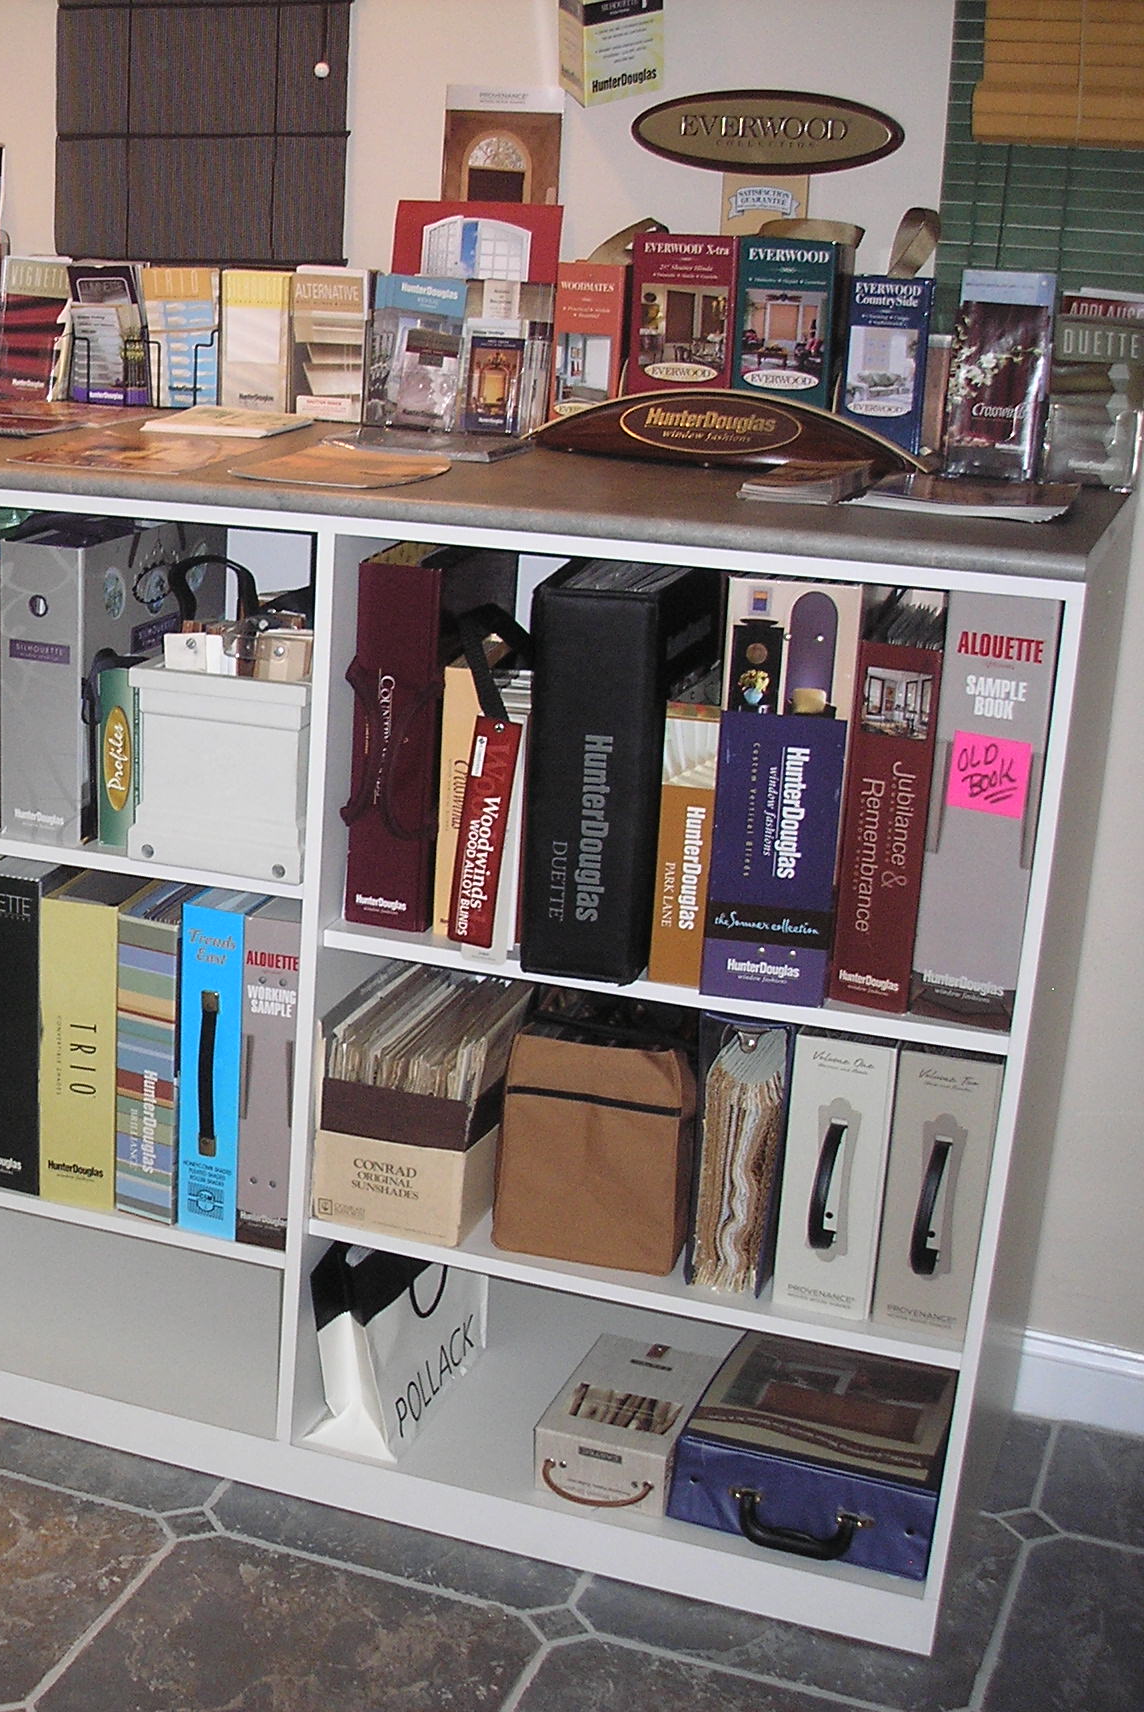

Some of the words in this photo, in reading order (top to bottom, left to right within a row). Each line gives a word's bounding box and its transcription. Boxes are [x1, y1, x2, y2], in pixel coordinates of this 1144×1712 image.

[592, 69, 657, 93] HunterDouglas
[680, 115, 848, 140] EVERWOOD
[716, 139, 816, 148] COLLECTION
[644, 242, 703, 254] EVERWOOD
[706, 245, 729, 256] X-tra
[749, 248, 830, 264] EVERWOOD
[296, 283, 359, 301] ALTERNATIVE
[401, 282, 458, 299] HunterDouglas
[561, 282, 614, 292] WOODMATES
[856, 282, 921, 297] EVERWOOD
[1064, 329, 1138, 359] DUETTE
[652, 367, 713, 378] EVERWOOD
[750, 374, 813, 386] EVERWOOD
[645, 406, 776, 434] HunterDouglas
[662, 429, 702, 442] window
[706, 432, 751, 444] fashions
[16, 643, 64, 656] SILHOUETTE
[958, 631, 1044, 664] ALOUETTE
[966, 675, 1027, 702] SAMPLE
[974, 697, 1014, 720] BOOK
[107, 723, 126, 792] Profiles
[958, 743, 999, 772] OLD
[767, 767, 778, 809] window
[962, 758, 1017, 798] BOOK
[14, 808, 64, 826] HunterDouglas
[746, 789, 757, 834] Vertical
[775, 747, 810, 880] HunterDouglas
[891, 760, 916, 866] Jubilance
[467, 820, 480, 857] WOOD
[575, 734, 614, 923] HunterDouglas
[762, 810, 775, 856] fashions
[469, 796, 501, 910] Woodwinds
[856, 777, 885, 934] Remembrance
[461, 860, 474, 898] ALLOY
[663, 862, 676, 896] PARK
[677, 805, 706, 931] HunterDouglas
[881, 869, 907, 889] &
[549, 841, 569, 920] DUETTE
[356, 893, 407, 912] HunterDouglas
[661, 898, 673, 928] LANE
[456, 899, 470, 936] BLINDS
[715, 914, 729, 926] the
[771, 918, 820, 936] collection
[189, 928, 236, 950] Trends
[197, 947, 227, 965] East
[246, 950, 299, 971] ALOUETTE
[727, 958, 800, 978] HunterDouglas
[839, 968, 899, 992] HunterDouglas
[923, 968, 1004, 996] HunterDouglas
[247, 985, 296, 1004] WORKING
[251, 999, 292, 1018] SAMPLE
[70, 1023, 97, 1097] TRIO
[812, 1051, 851, 1066] Volume
[853, 1058, 874, 1069] One
[919, 1069, 956, 1084] Volume
[142, 1070, 158, 1174] HunterDouglas
[48, 1160, 103, 1179] HunterDouglas
[353, 1158, 417, 1178] CONRAD
[357, 1171, 413, 1188] ORIGINAL
[351, 1180, 419, 1200] SUNSHADES
[787, 1283, 855, 1303] PROVENANCE
[887, 1304, 956, 1323] PROVENANCE
[395, 1314, 474, 1438] POLLACK
